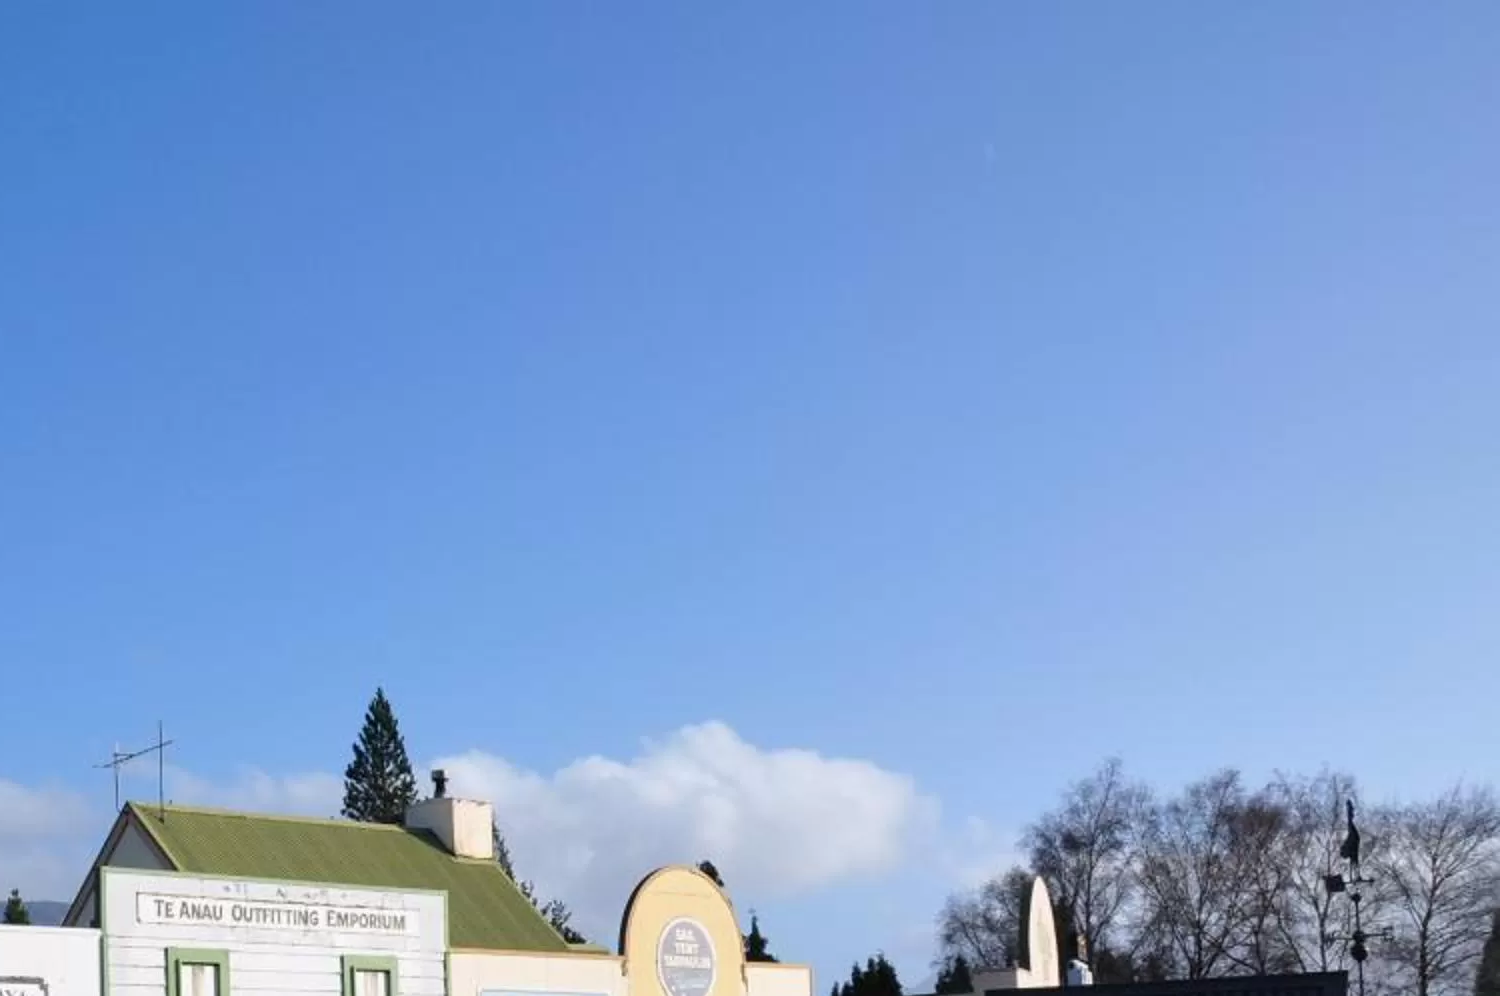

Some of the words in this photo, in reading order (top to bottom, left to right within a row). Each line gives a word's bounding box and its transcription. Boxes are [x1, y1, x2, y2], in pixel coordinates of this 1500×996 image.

[153, 899, 174, 918] TE
[179, 902, 223, 921] ANAU
[231, 904, 320, 927] OUTFITTING
[327, 909, 406, 930] EMPORIUM
